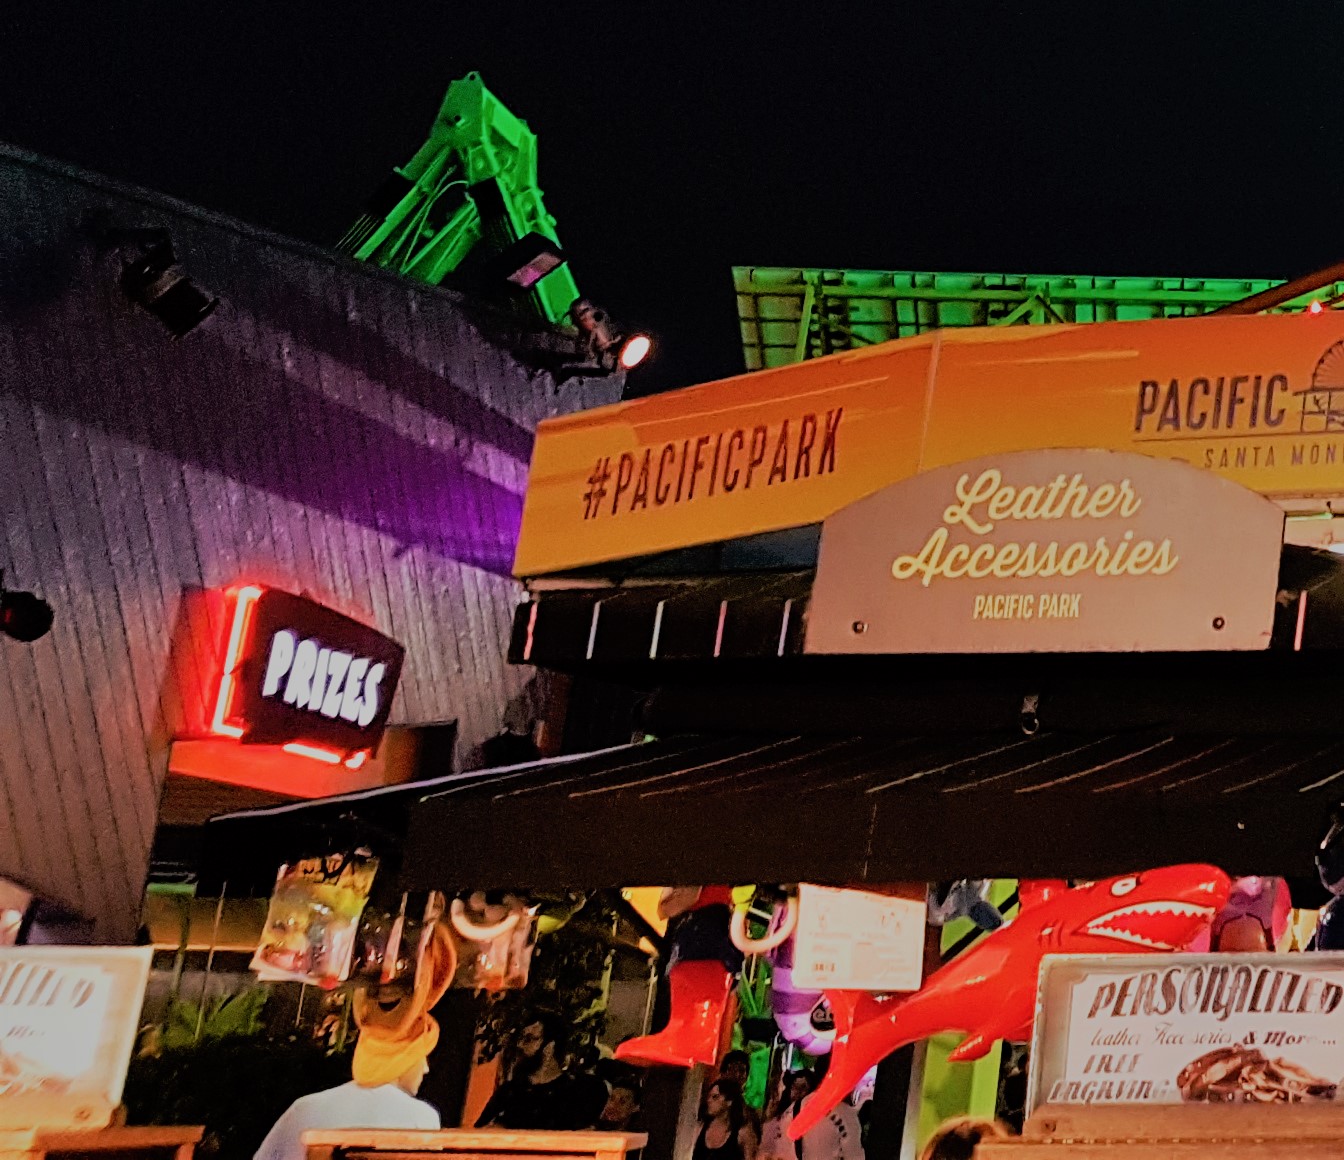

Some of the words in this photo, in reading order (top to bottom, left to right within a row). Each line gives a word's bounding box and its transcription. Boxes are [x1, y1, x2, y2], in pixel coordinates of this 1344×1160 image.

[1133, 374, 1289, 433] PACIFIC
[583, 407, 843, 520] #PACIFICPARK
[1204, 445, 1276, 470] SANTA
[943, 469, 1142, 535] Leather
[891, 527, 1180, 587] Accessories
[972, 594, 1034, 620] PACIFIC
[1038, 593, 1082, 619] PARK
[262, 629, 386, 727] PRIZES
[1087, 966, 1344, 1022] PERSONALIZED
